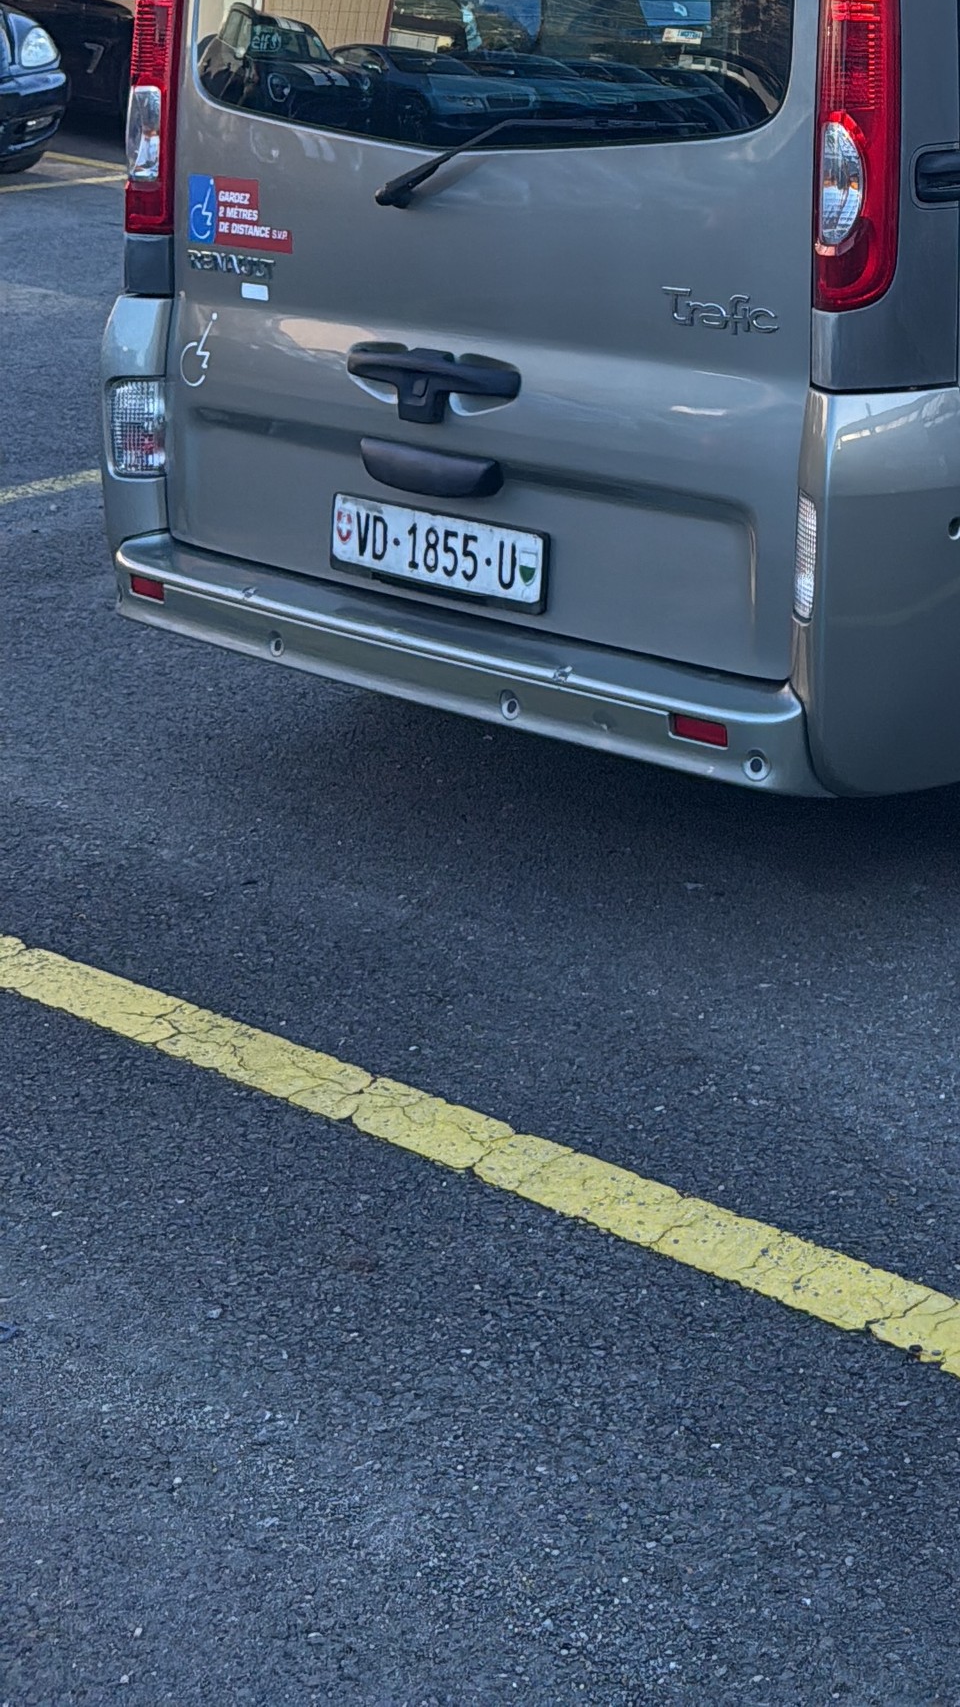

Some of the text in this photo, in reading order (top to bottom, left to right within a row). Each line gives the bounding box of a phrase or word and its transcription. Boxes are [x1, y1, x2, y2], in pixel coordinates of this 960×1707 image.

[218, 190, 251, 205] GARDEZ
[218, 206, 224, 218] 2
[218, 221, 229, 233] DE
[231, 223, 271, 238] DISTANCE
[661, 286, 780, 336] Trafic
